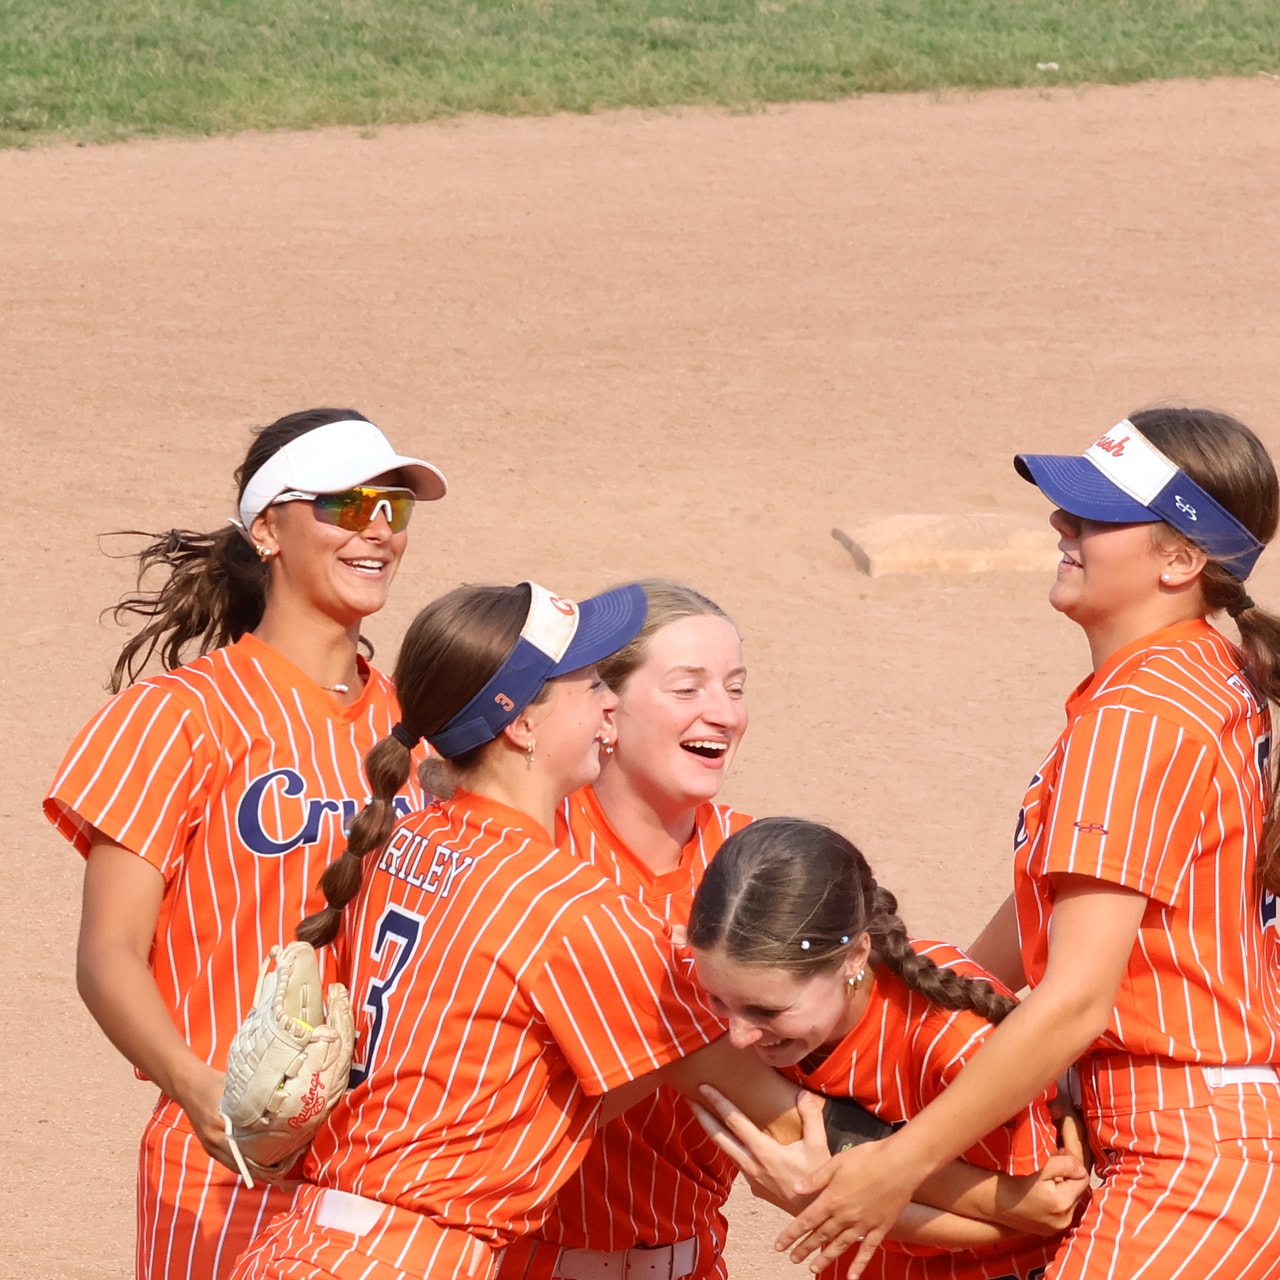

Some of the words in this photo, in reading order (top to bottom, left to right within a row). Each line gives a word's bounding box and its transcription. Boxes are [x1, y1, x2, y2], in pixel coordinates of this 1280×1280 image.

[493, 692, 516, 712] 3
[378, 826, 474, 898] RILEY
[347, 901, 426, 1093] 3
[287, 1071, 326, 1129] Rawlings
